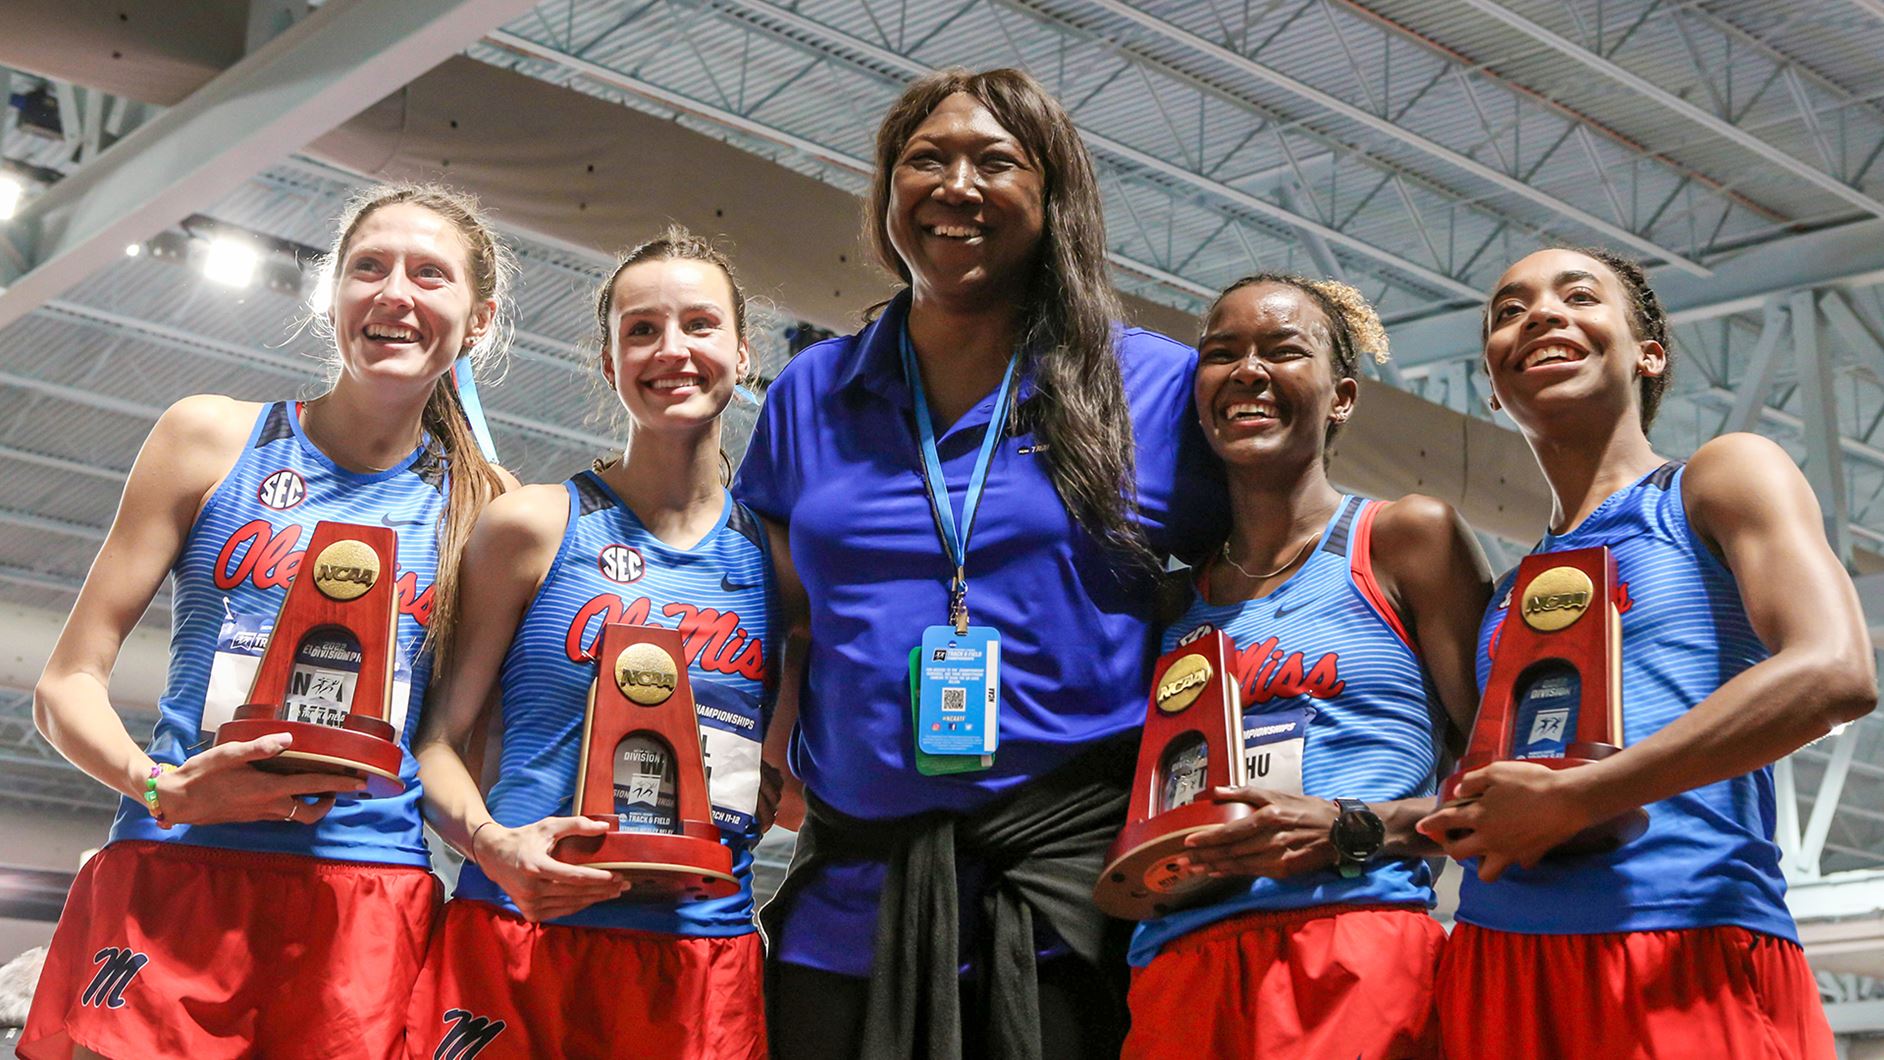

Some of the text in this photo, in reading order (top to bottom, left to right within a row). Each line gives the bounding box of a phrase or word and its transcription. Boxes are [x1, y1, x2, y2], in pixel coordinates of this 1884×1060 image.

[260, 470, 304, 509] SEC
[316, 564, 375, 587] NCAA
[601, 546, 643, 582] SEC
[1525, 591, 1588, 614] NCAA
[662, 602, 768, 689] Mis
[621, 668, 675, 691] NCAA
[1158, 668, 1208, 703] NCAA
[623, 750, 660, 763] DIVISION
[1246, 753, 1271, 780] HU
[629, 814, 648, 824] TRACK
[654, 816, 671, 826] FIELD
[724, 813, 741, 825] 11-12
[82, 946, 150, 1010] M
[433, 1007, 507, 1060] M
